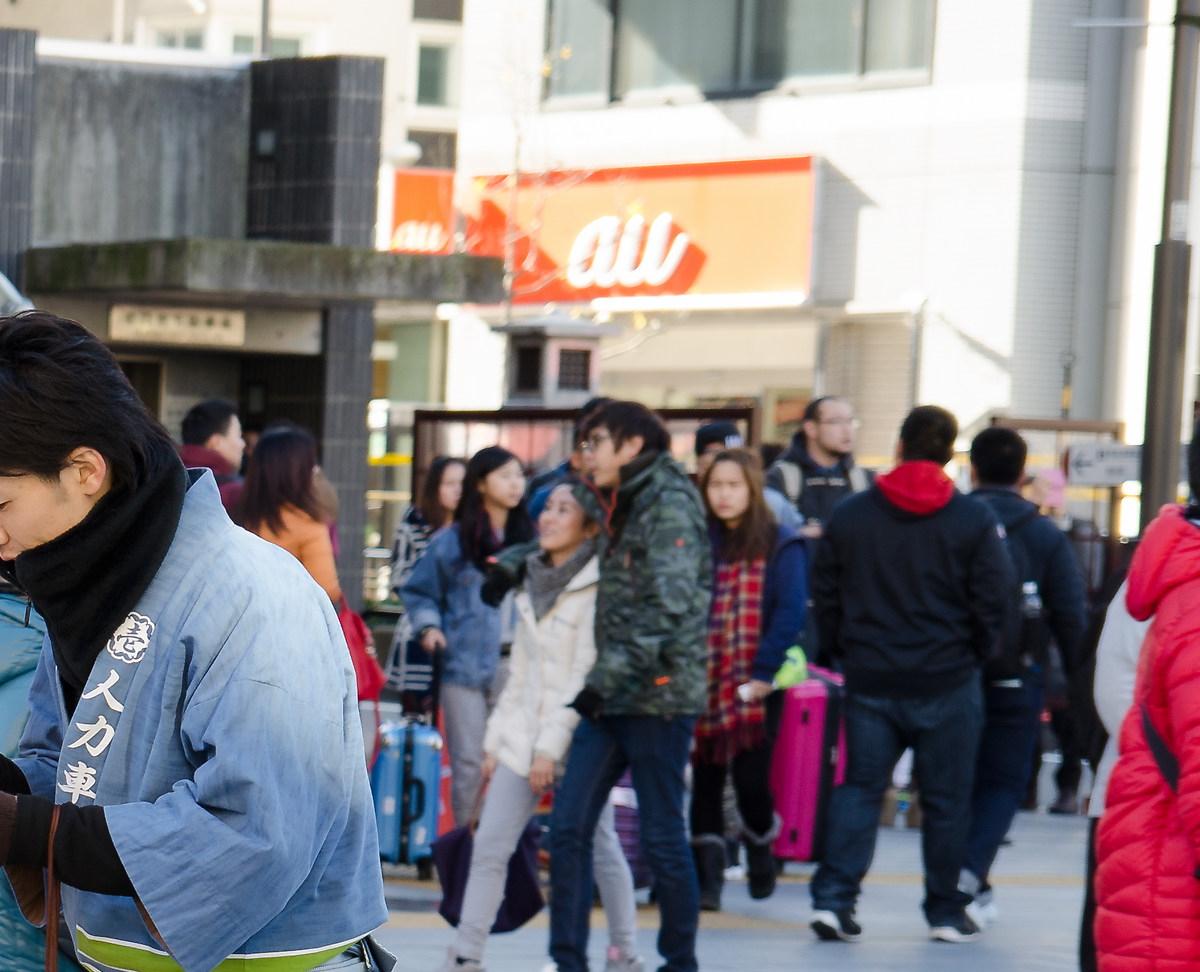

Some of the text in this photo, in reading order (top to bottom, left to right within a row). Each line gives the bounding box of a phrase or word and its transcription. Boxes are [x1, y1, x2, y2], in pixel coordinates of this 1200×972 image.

[392, 220, 448, 252] au
[567, 211, 688, 288] au
[57, 669, 125, 805] 人力車
